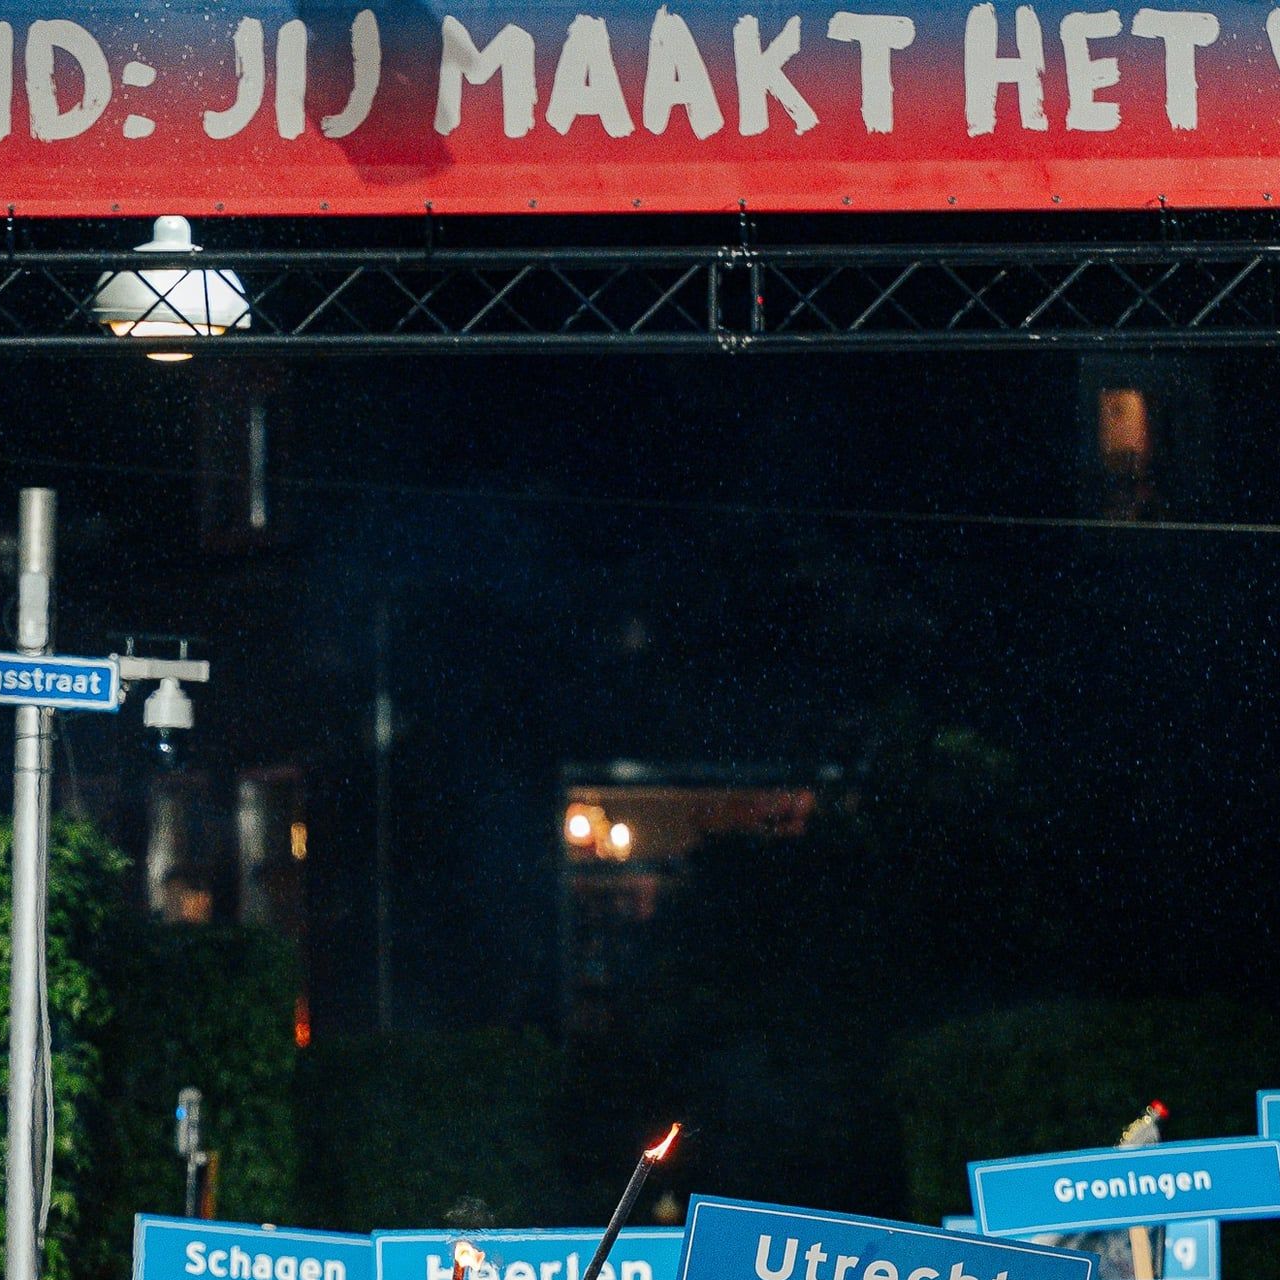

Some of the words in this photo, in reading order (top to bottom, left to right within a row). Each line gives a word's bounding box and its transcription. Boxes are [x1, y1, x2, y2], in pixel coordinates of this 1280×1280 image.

[203, 8, 380, 140] JIJ
[434, 4, 917, 138] MAAKT
[964, 3, 1220, 137] HET
[1053, 1166, 1212, 1205] Groningen
